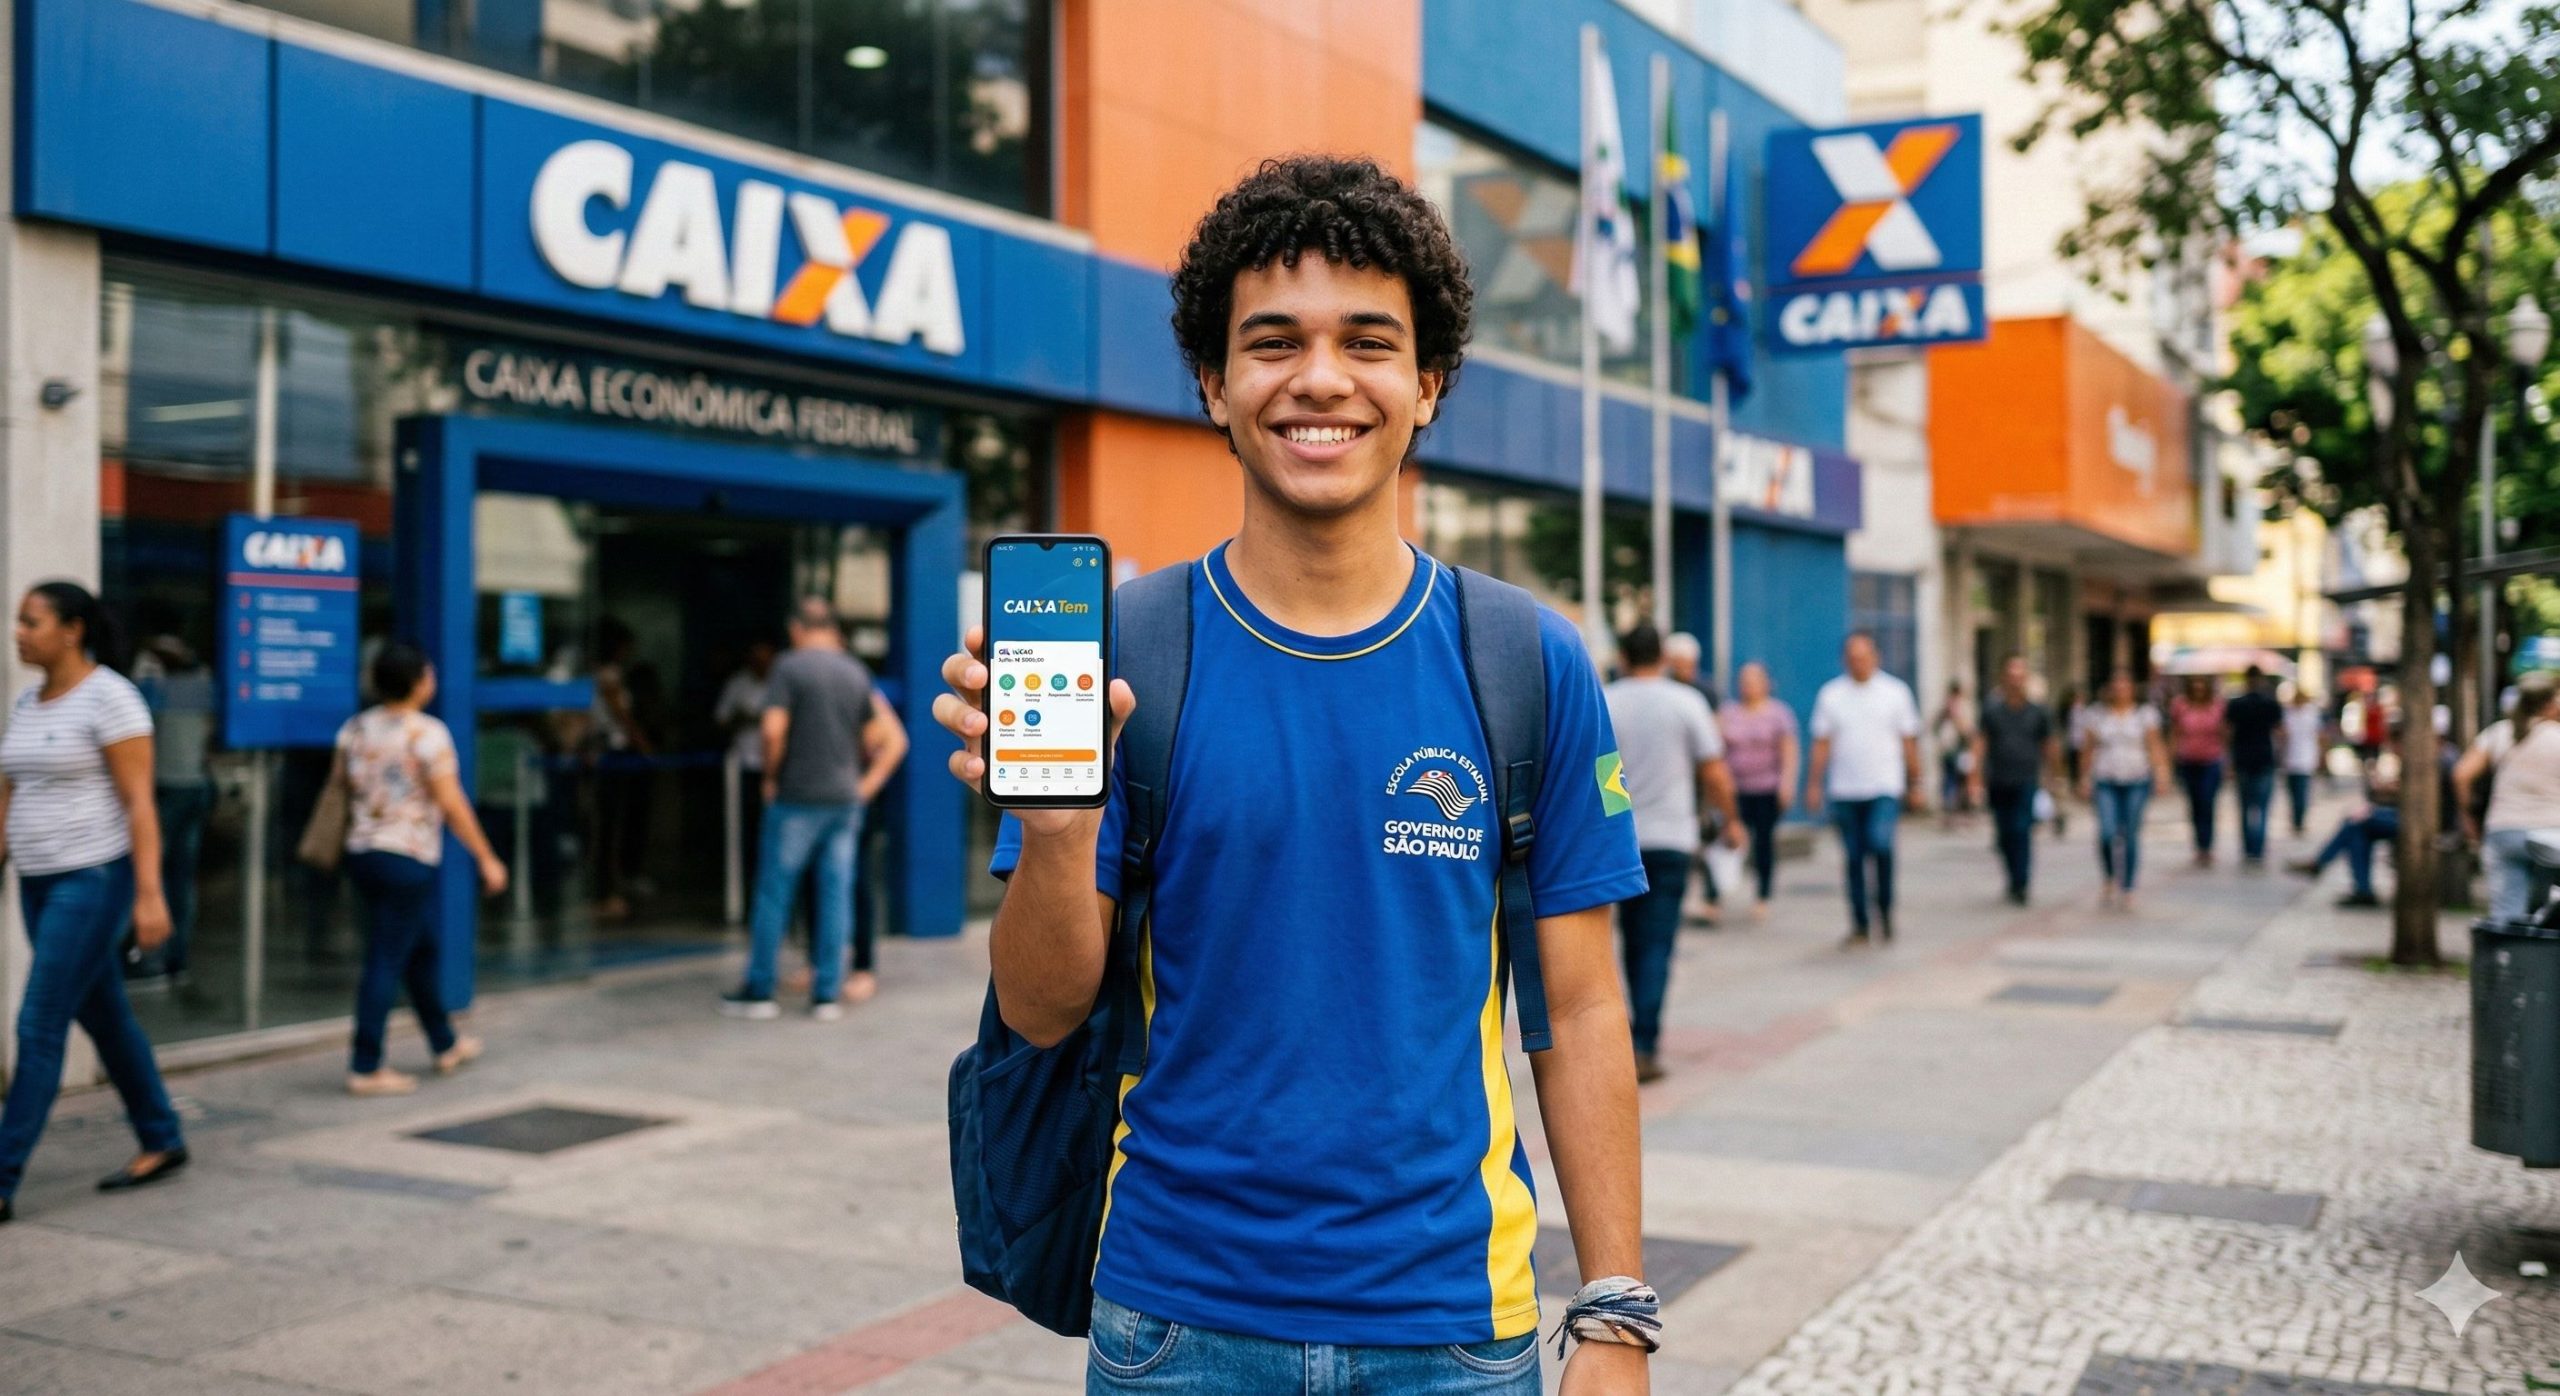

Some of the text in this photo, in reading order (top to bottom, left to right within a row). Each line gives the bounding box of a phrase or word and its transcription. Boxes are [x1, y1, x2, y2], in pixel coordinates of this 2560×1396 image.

[530, 140, 965, 356] CAIXA
[1780, 284, 1971, 345] CAIXA
[465, 349, 587, 410] CAIXA
[243, 531, 346, 572] CAIXA
[1003, 599, 1089, 614] CAIXA Tem
[1386, 747, 1489, 804] ESCOLA PÚBLICA ESTADUAL
[1383, 835, 1480, 860] SÃO PAULO
[1384, 820, 1484, 842] GOVERNO DE
